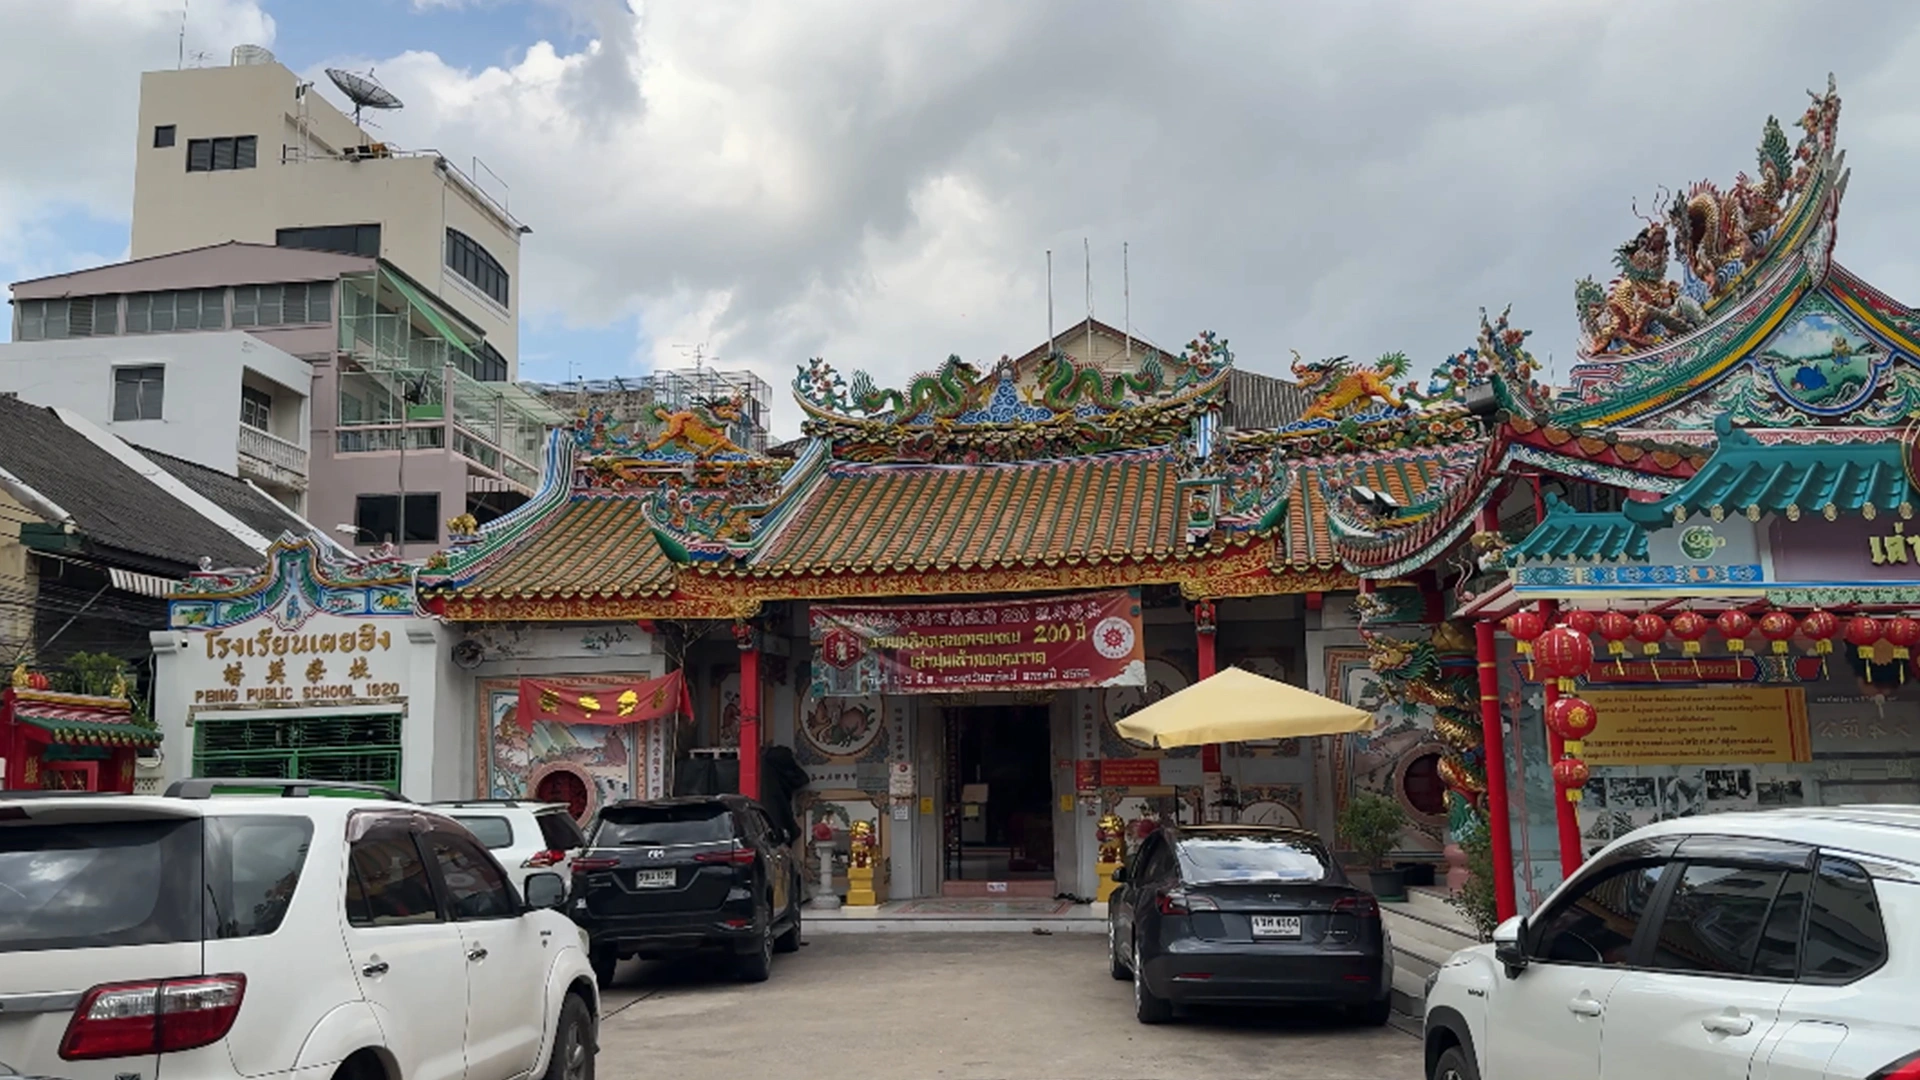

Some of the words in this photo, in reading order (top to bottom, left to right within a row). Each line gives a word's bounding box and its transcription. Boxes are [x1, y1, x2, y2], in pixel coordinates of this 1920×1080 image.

[203, 623, 392, 659] โรงเรียนเผยอิง
[1034, 622, 1071, 644] 200
[1075, 621, 1087, 640] ปี
[246, 687, 294, 702] PUBLIC
[302, 684, 356, 699] SCHOOL
[365, 682, 401, 697] 1920
